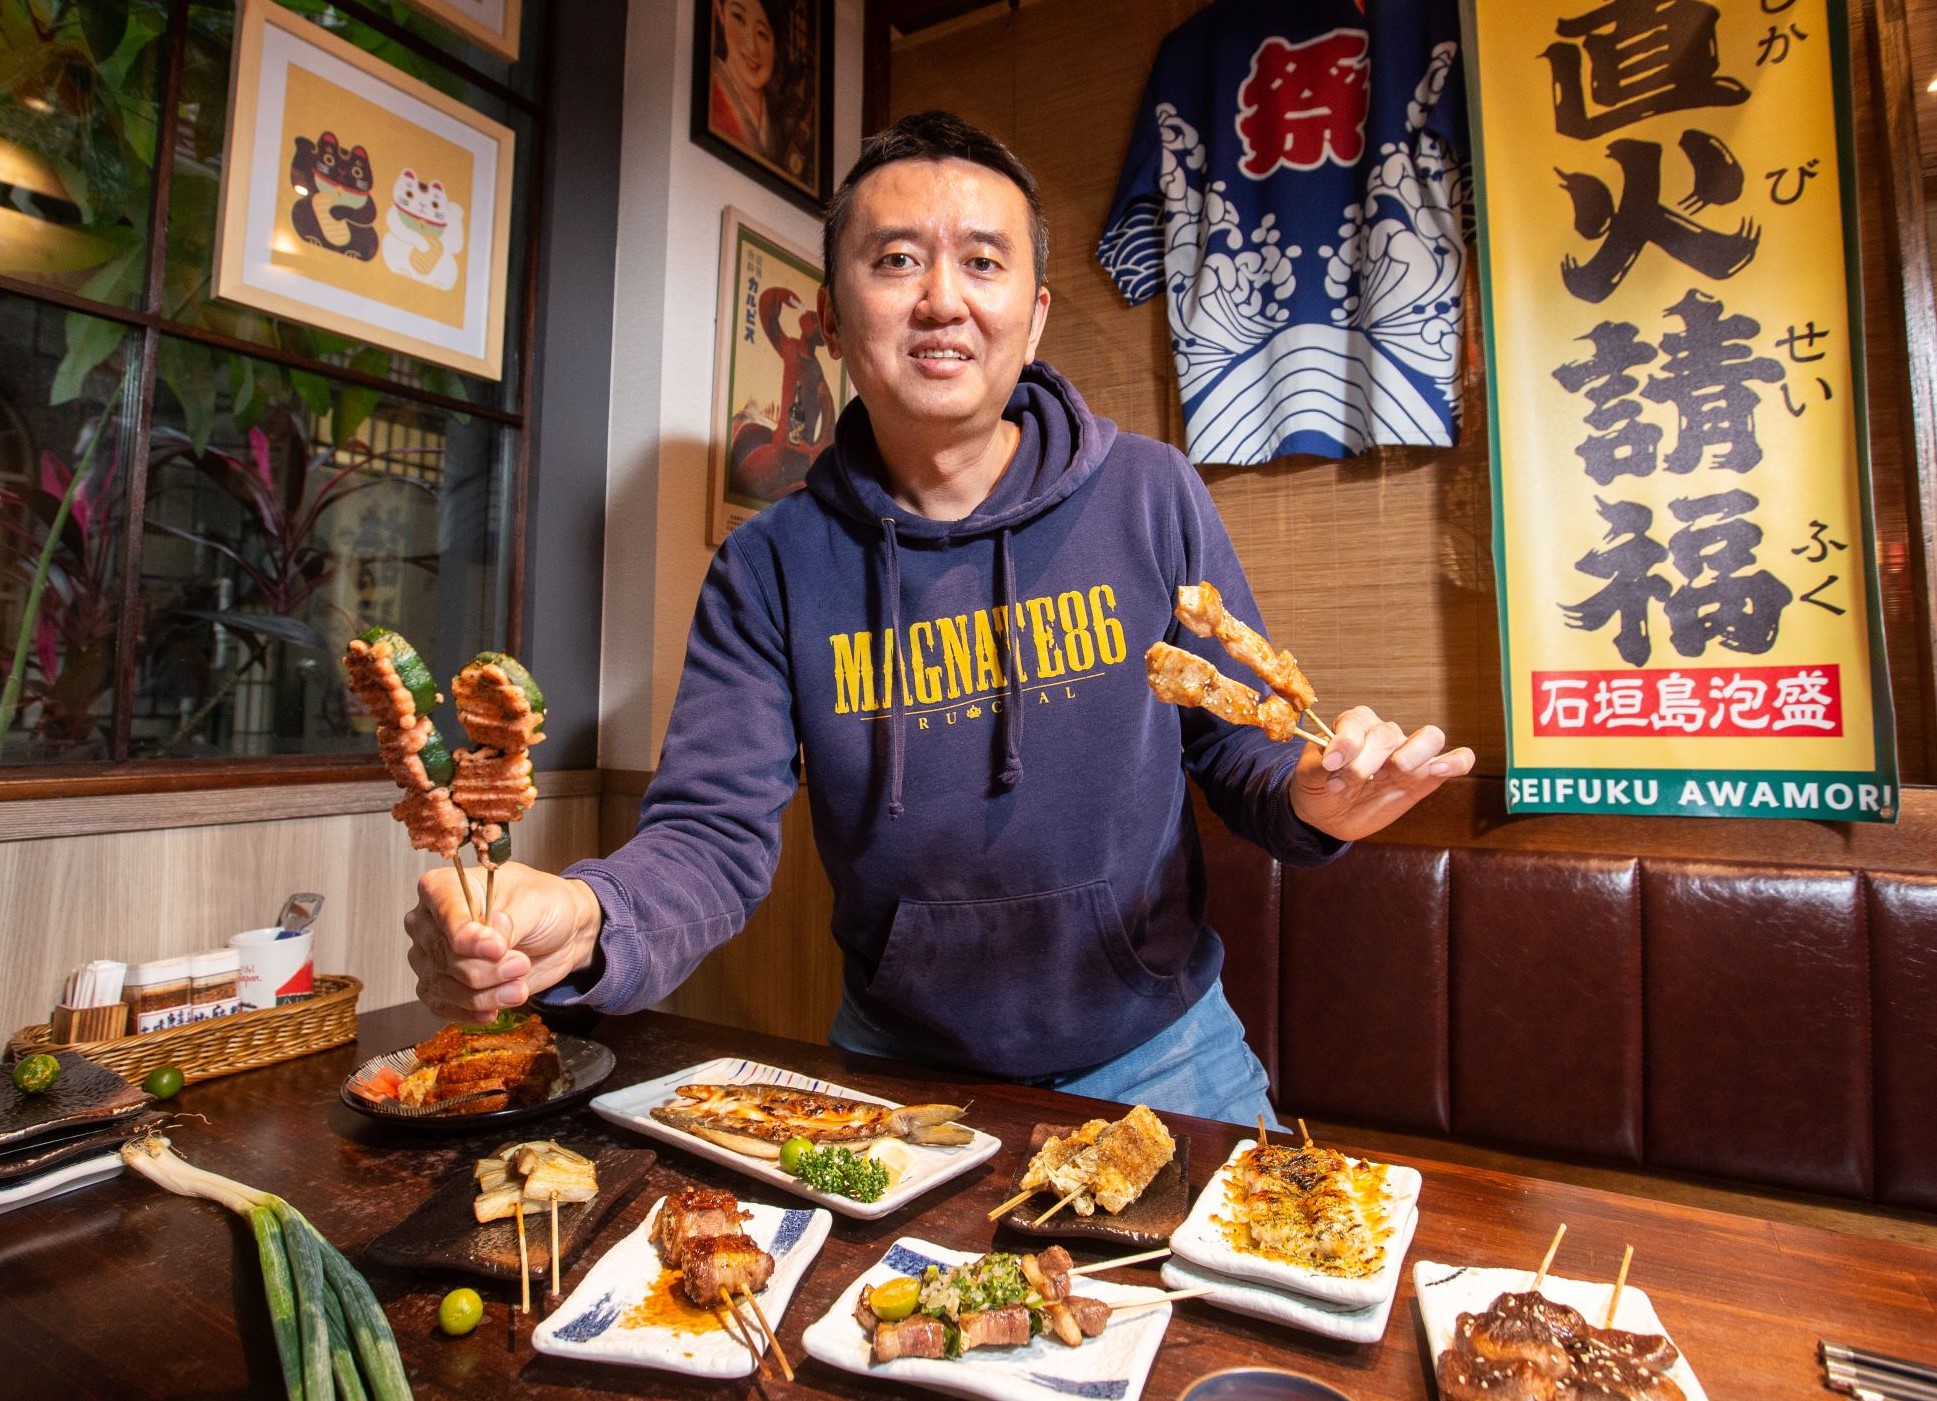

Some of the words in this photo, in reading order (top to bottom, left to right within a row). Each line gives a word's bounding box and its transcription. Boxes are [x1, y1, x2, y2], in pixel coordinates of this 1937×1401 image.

[1765, 158, 1819, 205] び
[1535, 0, 1793, 667] 直火請福
[1775, 322, 1833, 417] せい
[1792, 520, 1848, 616] ふく
[829, 584, 1127, 714] MAGNATE86
[1539, 669, 1836, 732] 石垣島泡盛
[1509, 778, 1660, 805] SEIFUKU
[1678, 780, 1892, 812] AWAMORI
